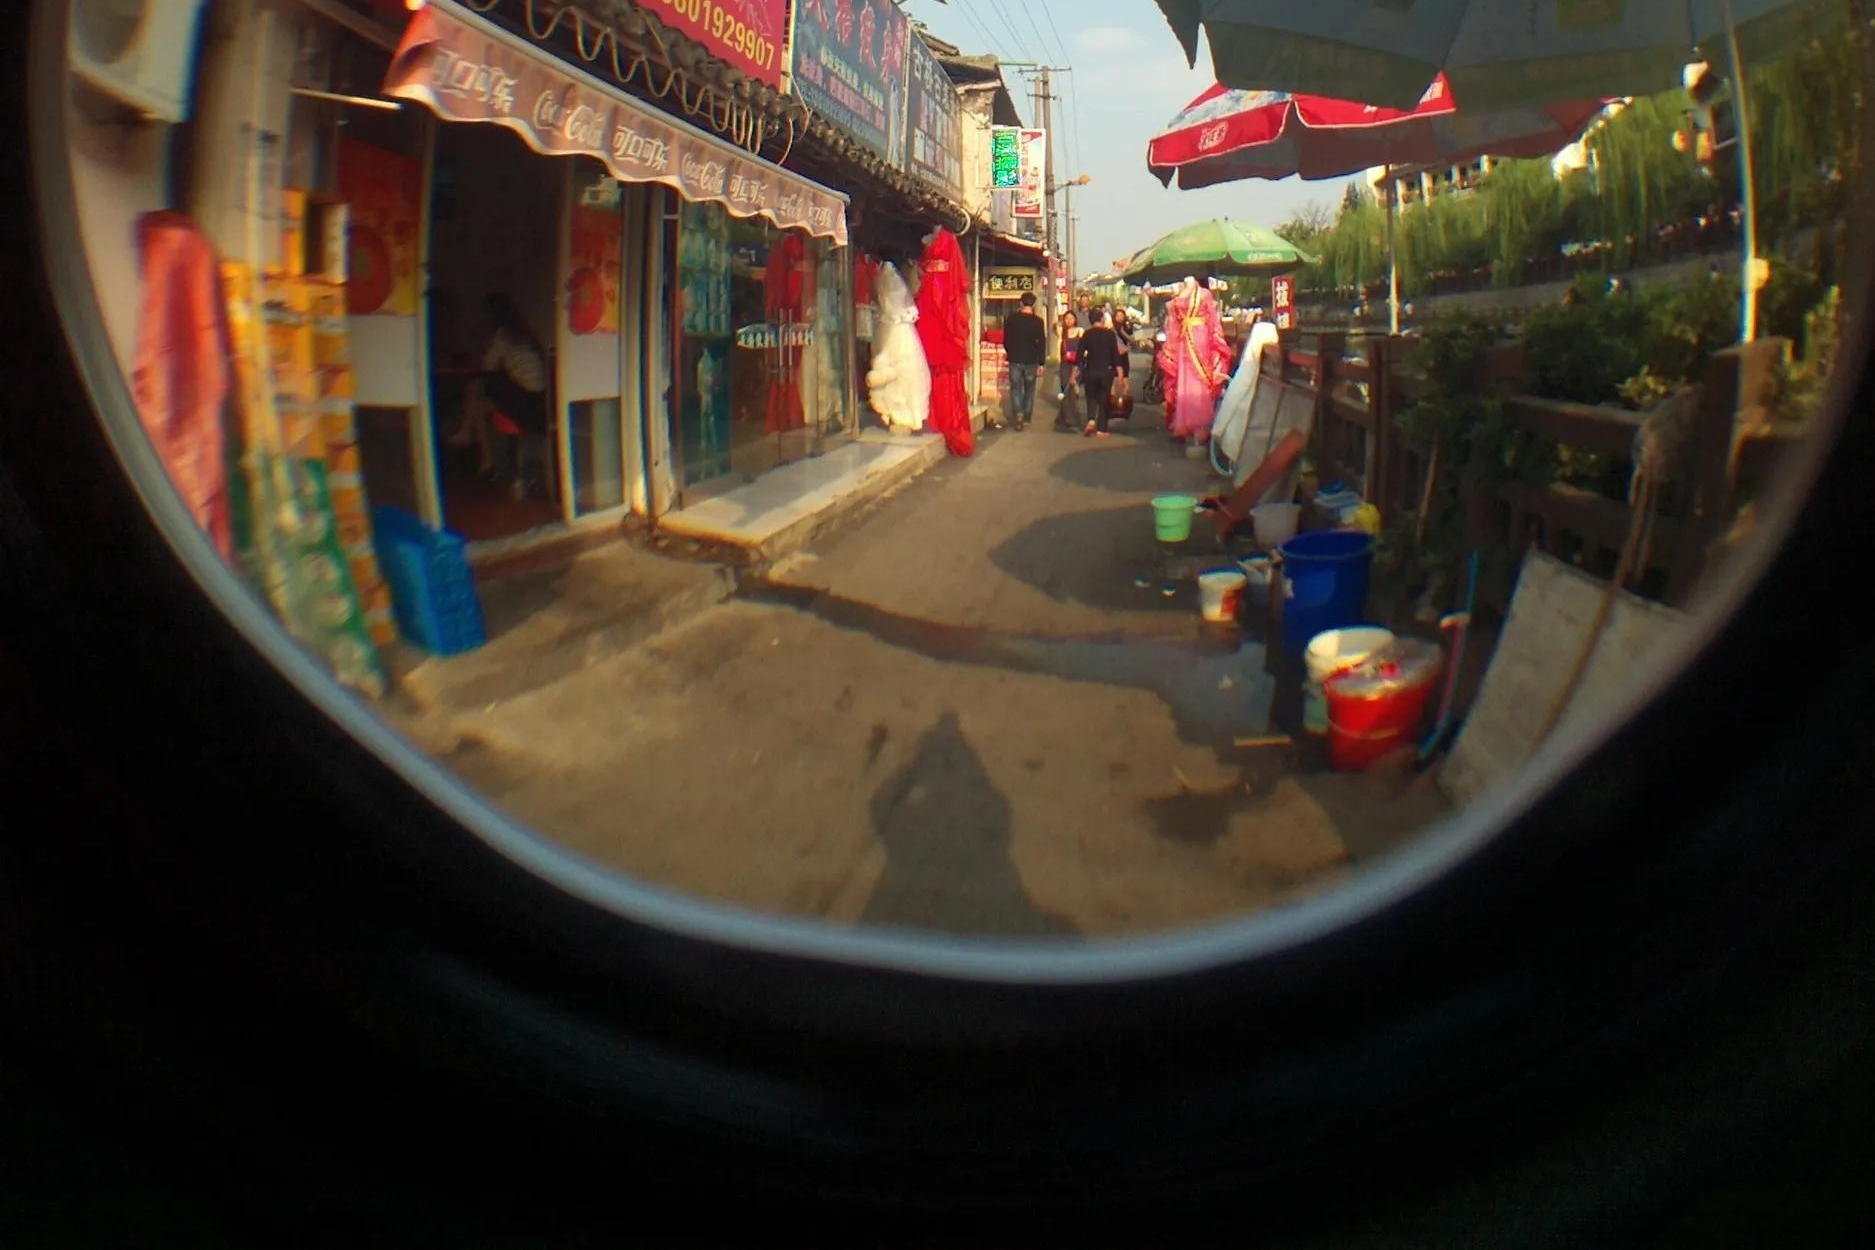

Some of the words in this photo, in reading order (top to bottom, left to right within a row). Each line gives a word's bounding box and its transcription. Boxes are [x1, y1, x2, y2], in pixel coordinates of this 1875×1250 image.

[612, 125, 670, 172] 可口可乐
[989, 275, 1033, 291] 便利店
